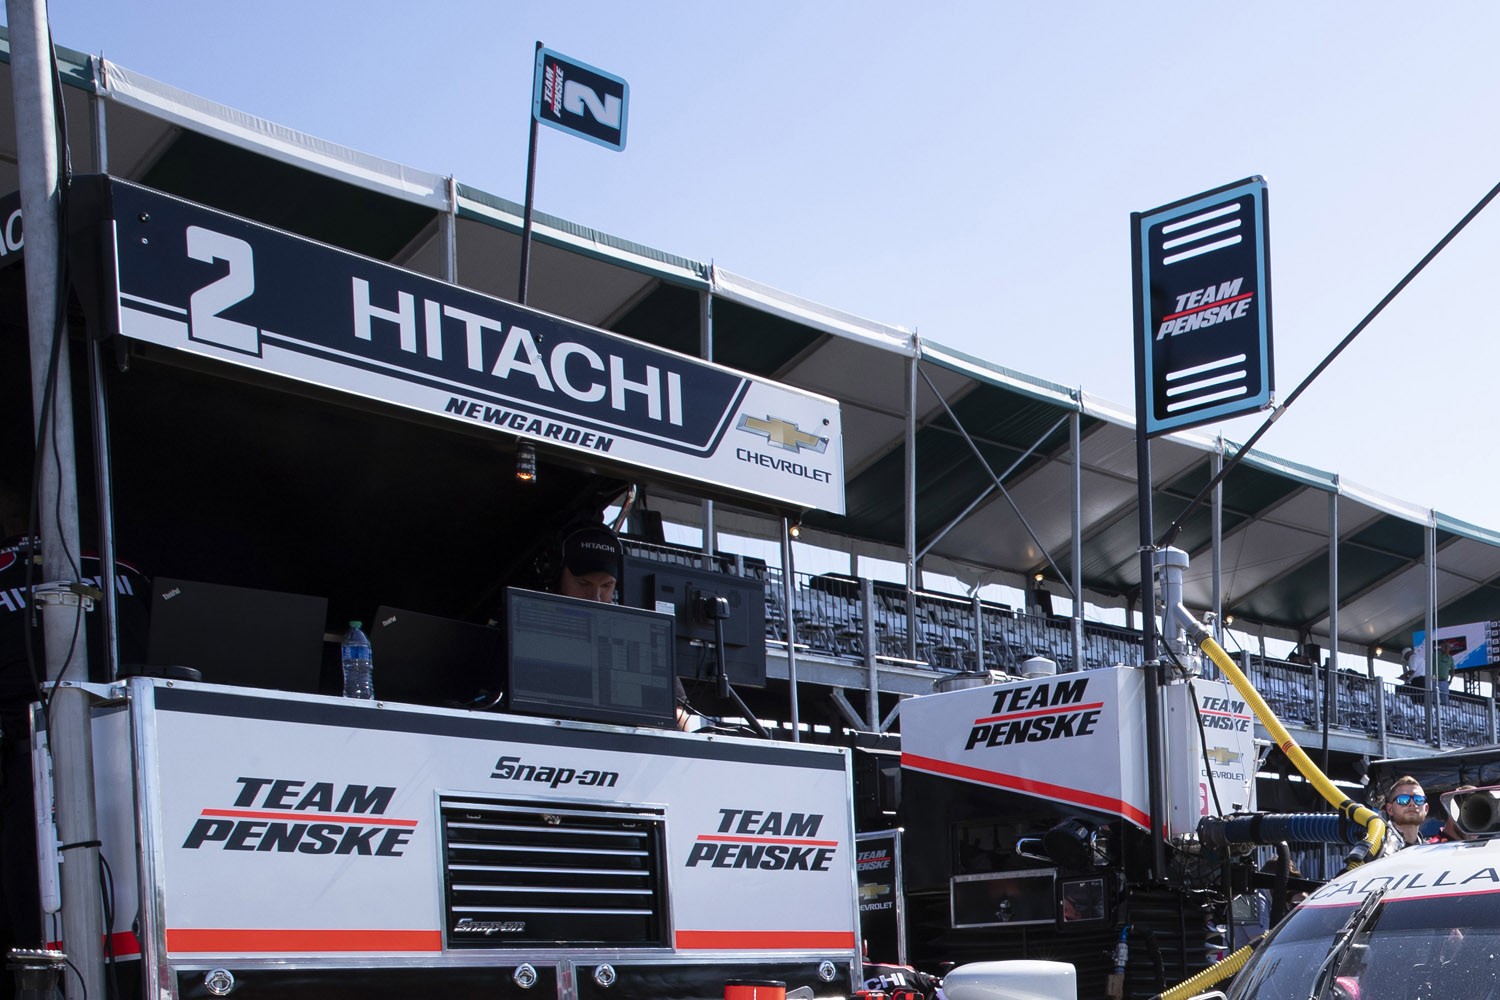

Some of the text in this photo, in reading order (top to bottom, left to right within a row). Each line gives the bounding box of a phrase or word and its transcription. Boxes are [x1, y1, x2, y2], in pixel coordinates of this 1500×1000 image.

[544, 65, 554, 104] TEAM
[552, 66, 564, 118] PENSKE
[563, 79, 621, 130] 2
[1174, 277, 1244, 313] TEAM
[185, 224, 684, 427] 2 HITACHI
[1156, 298, 1253, 341] PENSKE
[445, 396, 614, 453] NEWGARDEN
[735, 447, 832, 484] CHEVROLET
[581, 541, 615, 553] HITACHI
[991, 677, 1090, 714] TEAM
[1202, 696, 1246, 715] TEAM
[964, 709, 1103, 751] PENSKE
[490, 755, 619, 788] Snap-on
[1201, 769, 1245, 781] CEVROLET
[233, 776, 397, 815] TEAM
[181, 818, 415, 857] PENSKE
[717, 808, 824, 837] TEAM
[685, 842, 836, 872] PENSKE
[857, 860, 891, 872] ENSKE
[858, 849, 887, 861] TEAM
[860, 901, 893, 912] EVROLET
[454, 918, 526, 935] Snap-on
